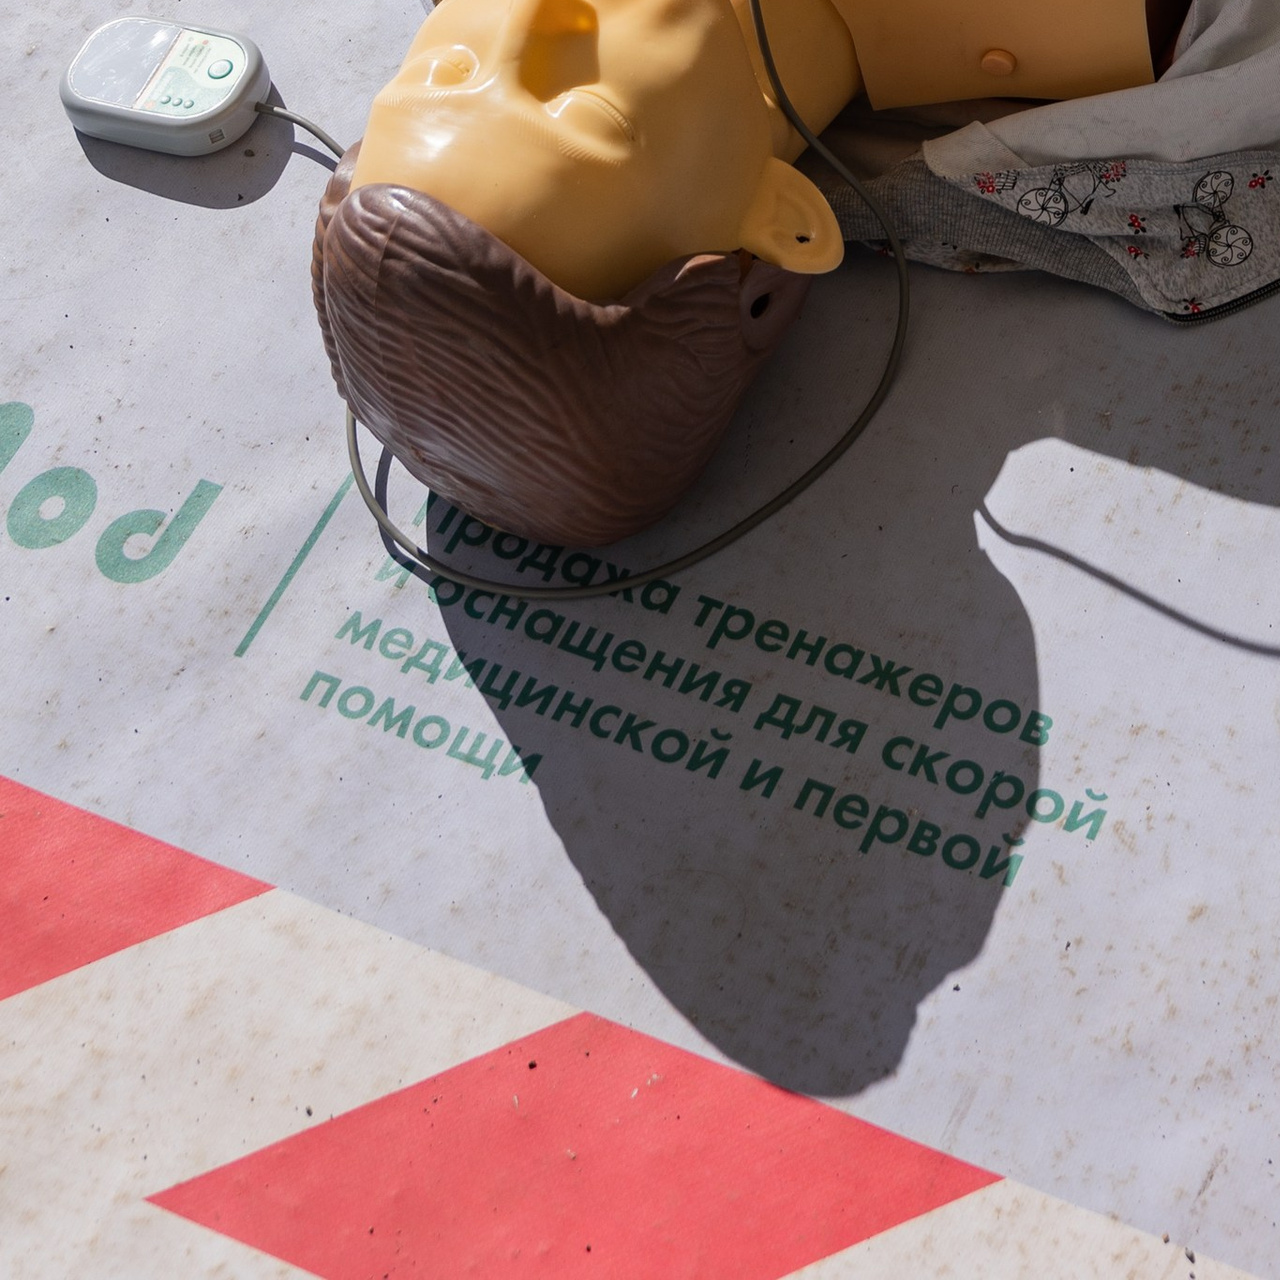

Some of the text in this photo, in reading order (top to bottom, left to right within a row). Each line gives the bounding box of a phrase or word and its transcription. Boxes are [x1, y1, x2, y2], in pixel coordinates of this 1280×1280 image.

[0, 401, 224, 584] od
[299, 670, 544, 785] помощи
[335, 610, 1025, 888] медицинской и первой
[374, 554, 1109, 841] и оснащения для скорой
[693, 593, 1054, 746] тренажеров
